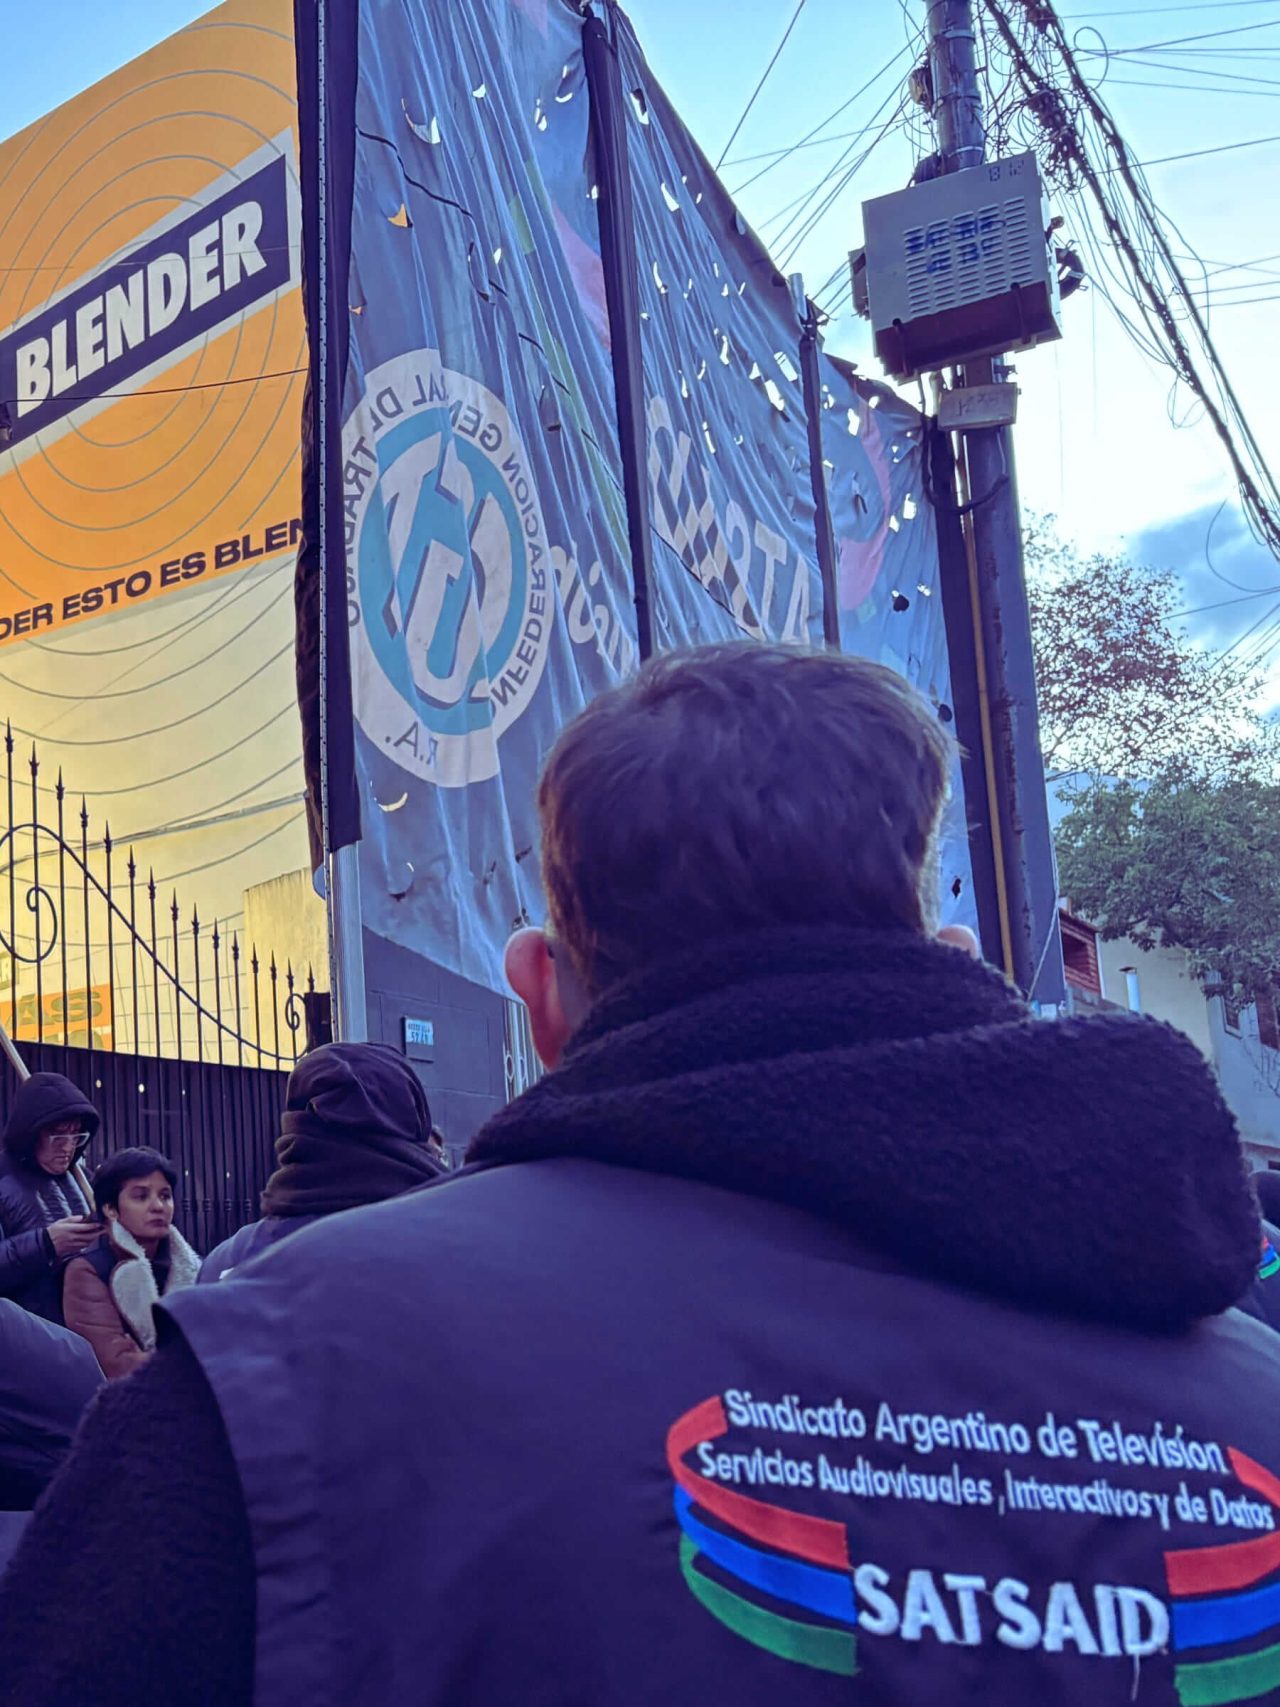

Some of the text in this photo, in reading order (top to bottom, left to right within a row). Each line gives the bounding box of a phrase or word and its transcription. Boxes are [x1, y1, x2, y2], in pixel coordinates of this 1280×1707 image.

[16, 201, 268, 418] BLENDER
[62, 570, 152, 620] ESTO
[160, 551, 207, 588] ES
[725, 1389, 867, 1438] Sindicato
[875, 1402, 1031, 1454] Argentino
[1037, 1411, 1078, 1459] de
[697, 1441, 815, 1487] Servicios
[1174, 1481, 1209, 1523] de
[1209, 1487, 1276, 1531] Datos
[854, 1563, 1170, 1657] SATSAID
